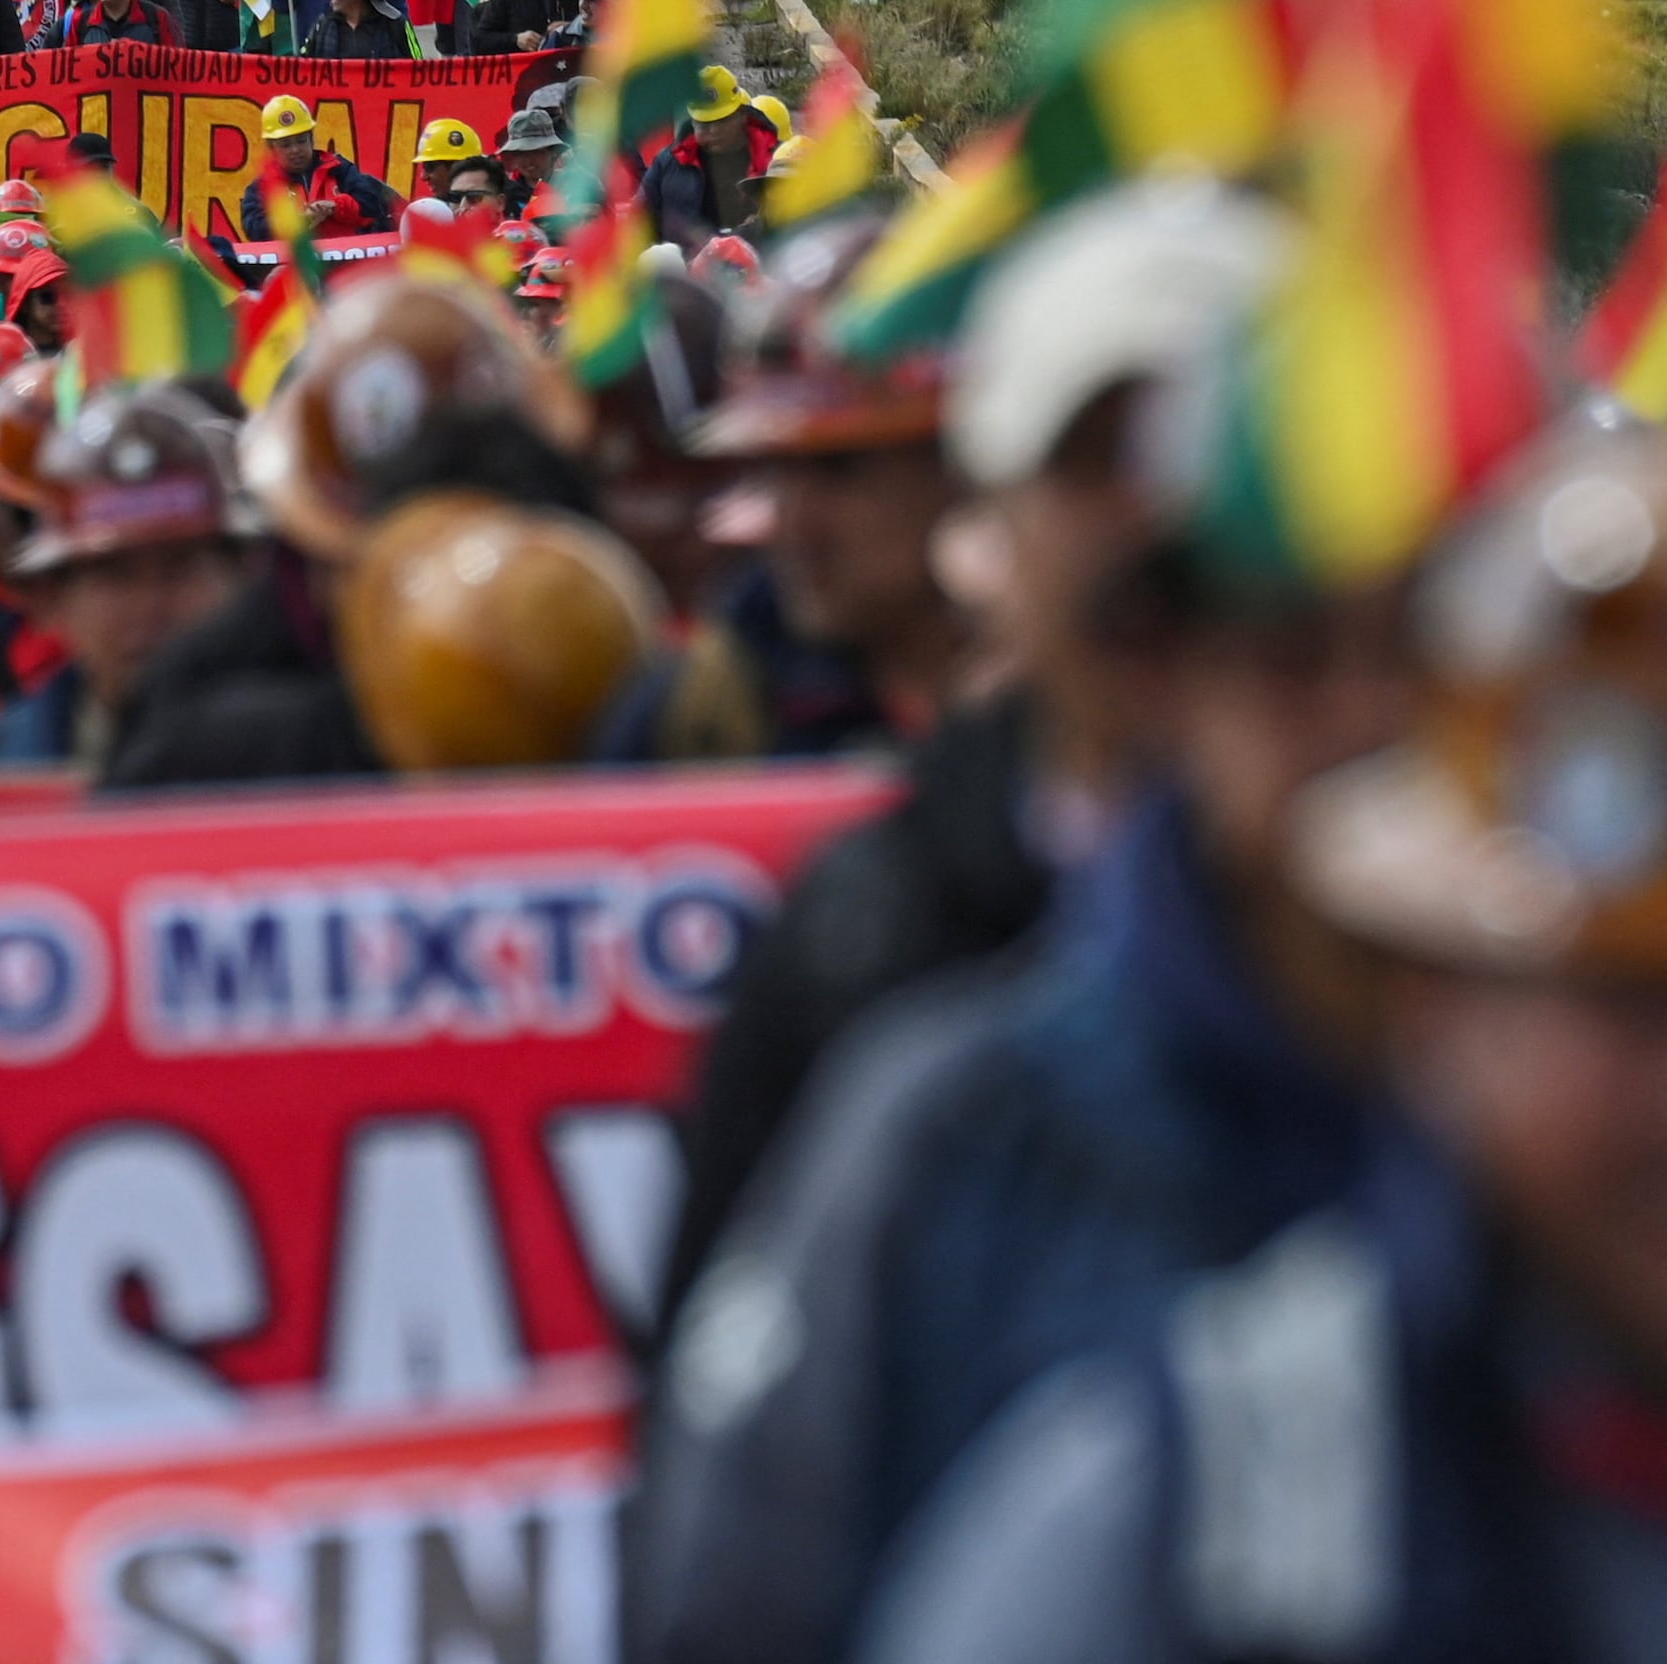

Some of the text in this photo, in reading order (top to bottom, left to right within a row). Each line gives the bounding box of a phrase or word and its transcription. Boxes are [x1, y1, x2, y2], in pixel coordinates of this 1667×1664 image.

[50, 45, 80, 84] DE
[96, 39, 242, 84] SEGURIDAD
[256, 57, 348, 87] SOCIAL
[365, 58, 395, 88] DE
[411, 53, 513, 87] BOLIVIA
[145, 866, 775, 1044] MIXTO
